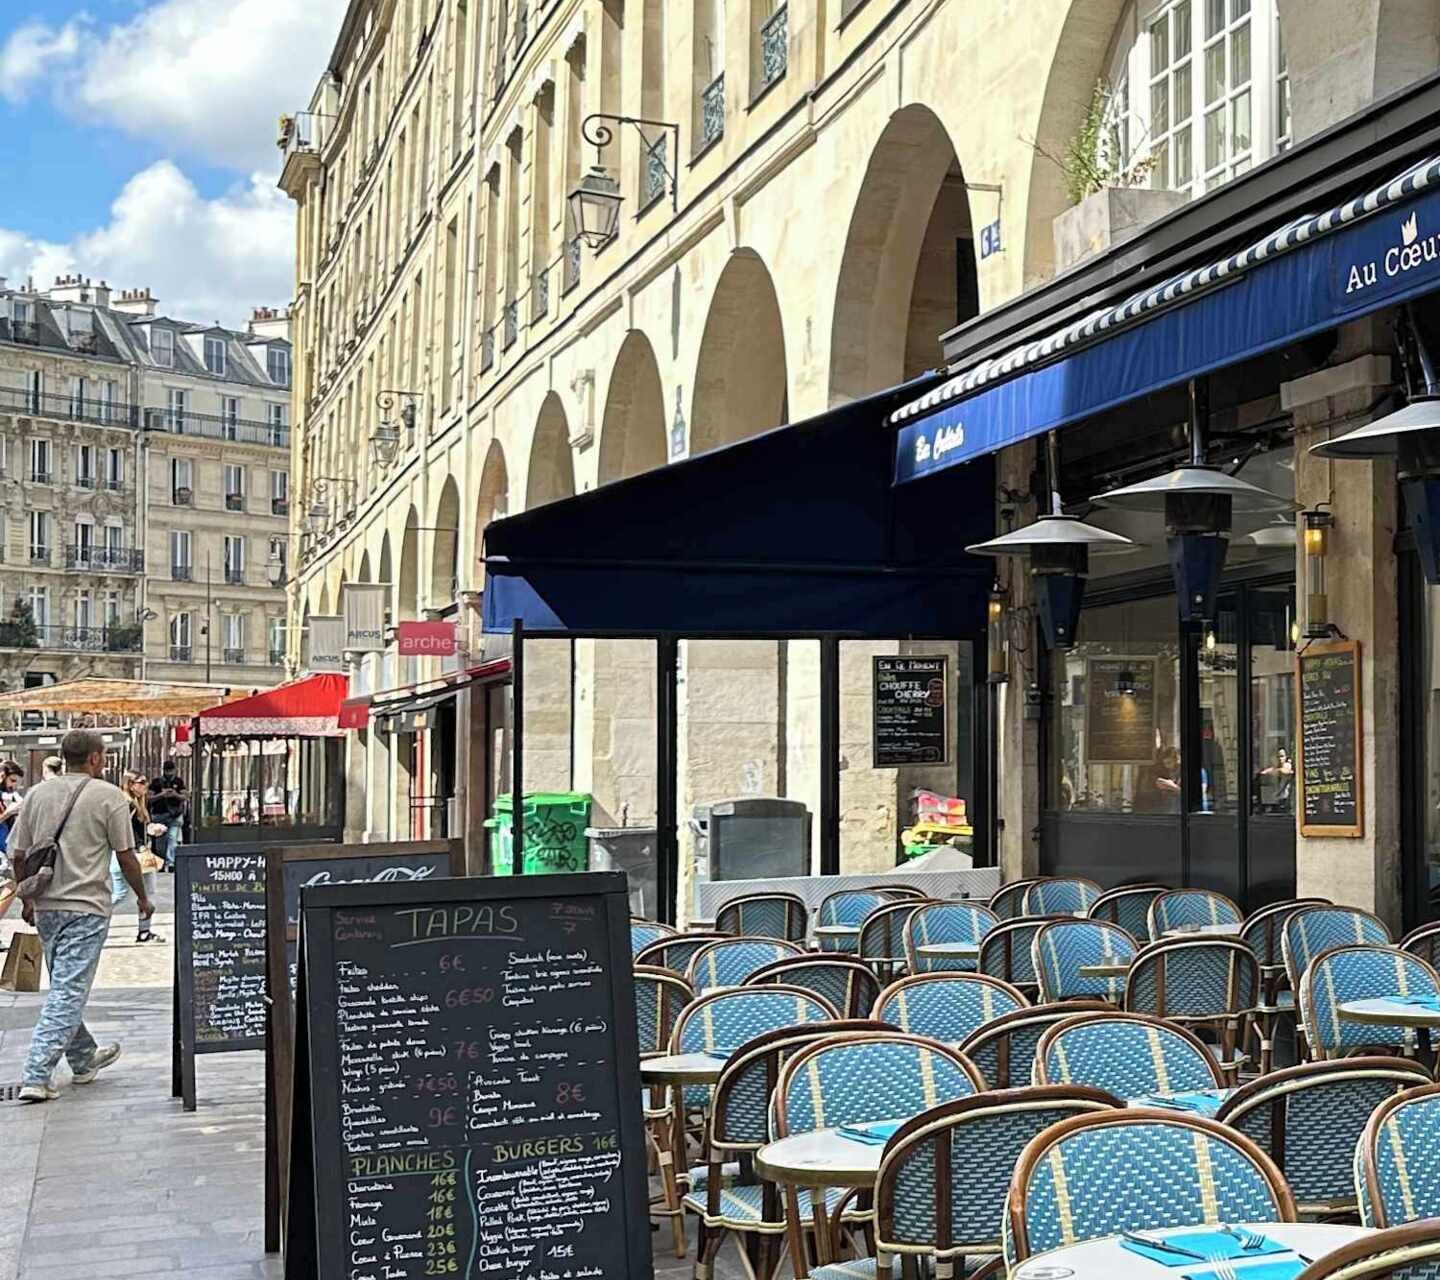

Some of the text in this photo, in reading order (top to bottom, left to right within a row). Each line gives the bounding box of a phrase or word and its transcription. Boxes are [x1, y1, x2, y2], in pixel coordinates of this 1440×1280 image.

[1345, 265, 1377, 294] Au
[348, 629, 381, 640] ARCUS
[402, 633, 451, 649] arche
[879, 681, 921, 691] CHOUFFE
[209, 870, 243, 881] 15H00
[393, 905, 519, 938] TAPAS
[444, 987, 495, 1009] 6€50
[555, 1082, 587, 1105] 8€
[491, 1135, 619, 1163] BURGERS 16€
[350, 1150, 456, 1177] PLANCHES
[427, 1188, 457, 1204] 16€
[426, 1205, 455, 1221] 18€
[425, 1222, 456, 1239] 20€
[426, 1240, 457, 1257] 23€
[424, 1257, 459, 1276] 25€
